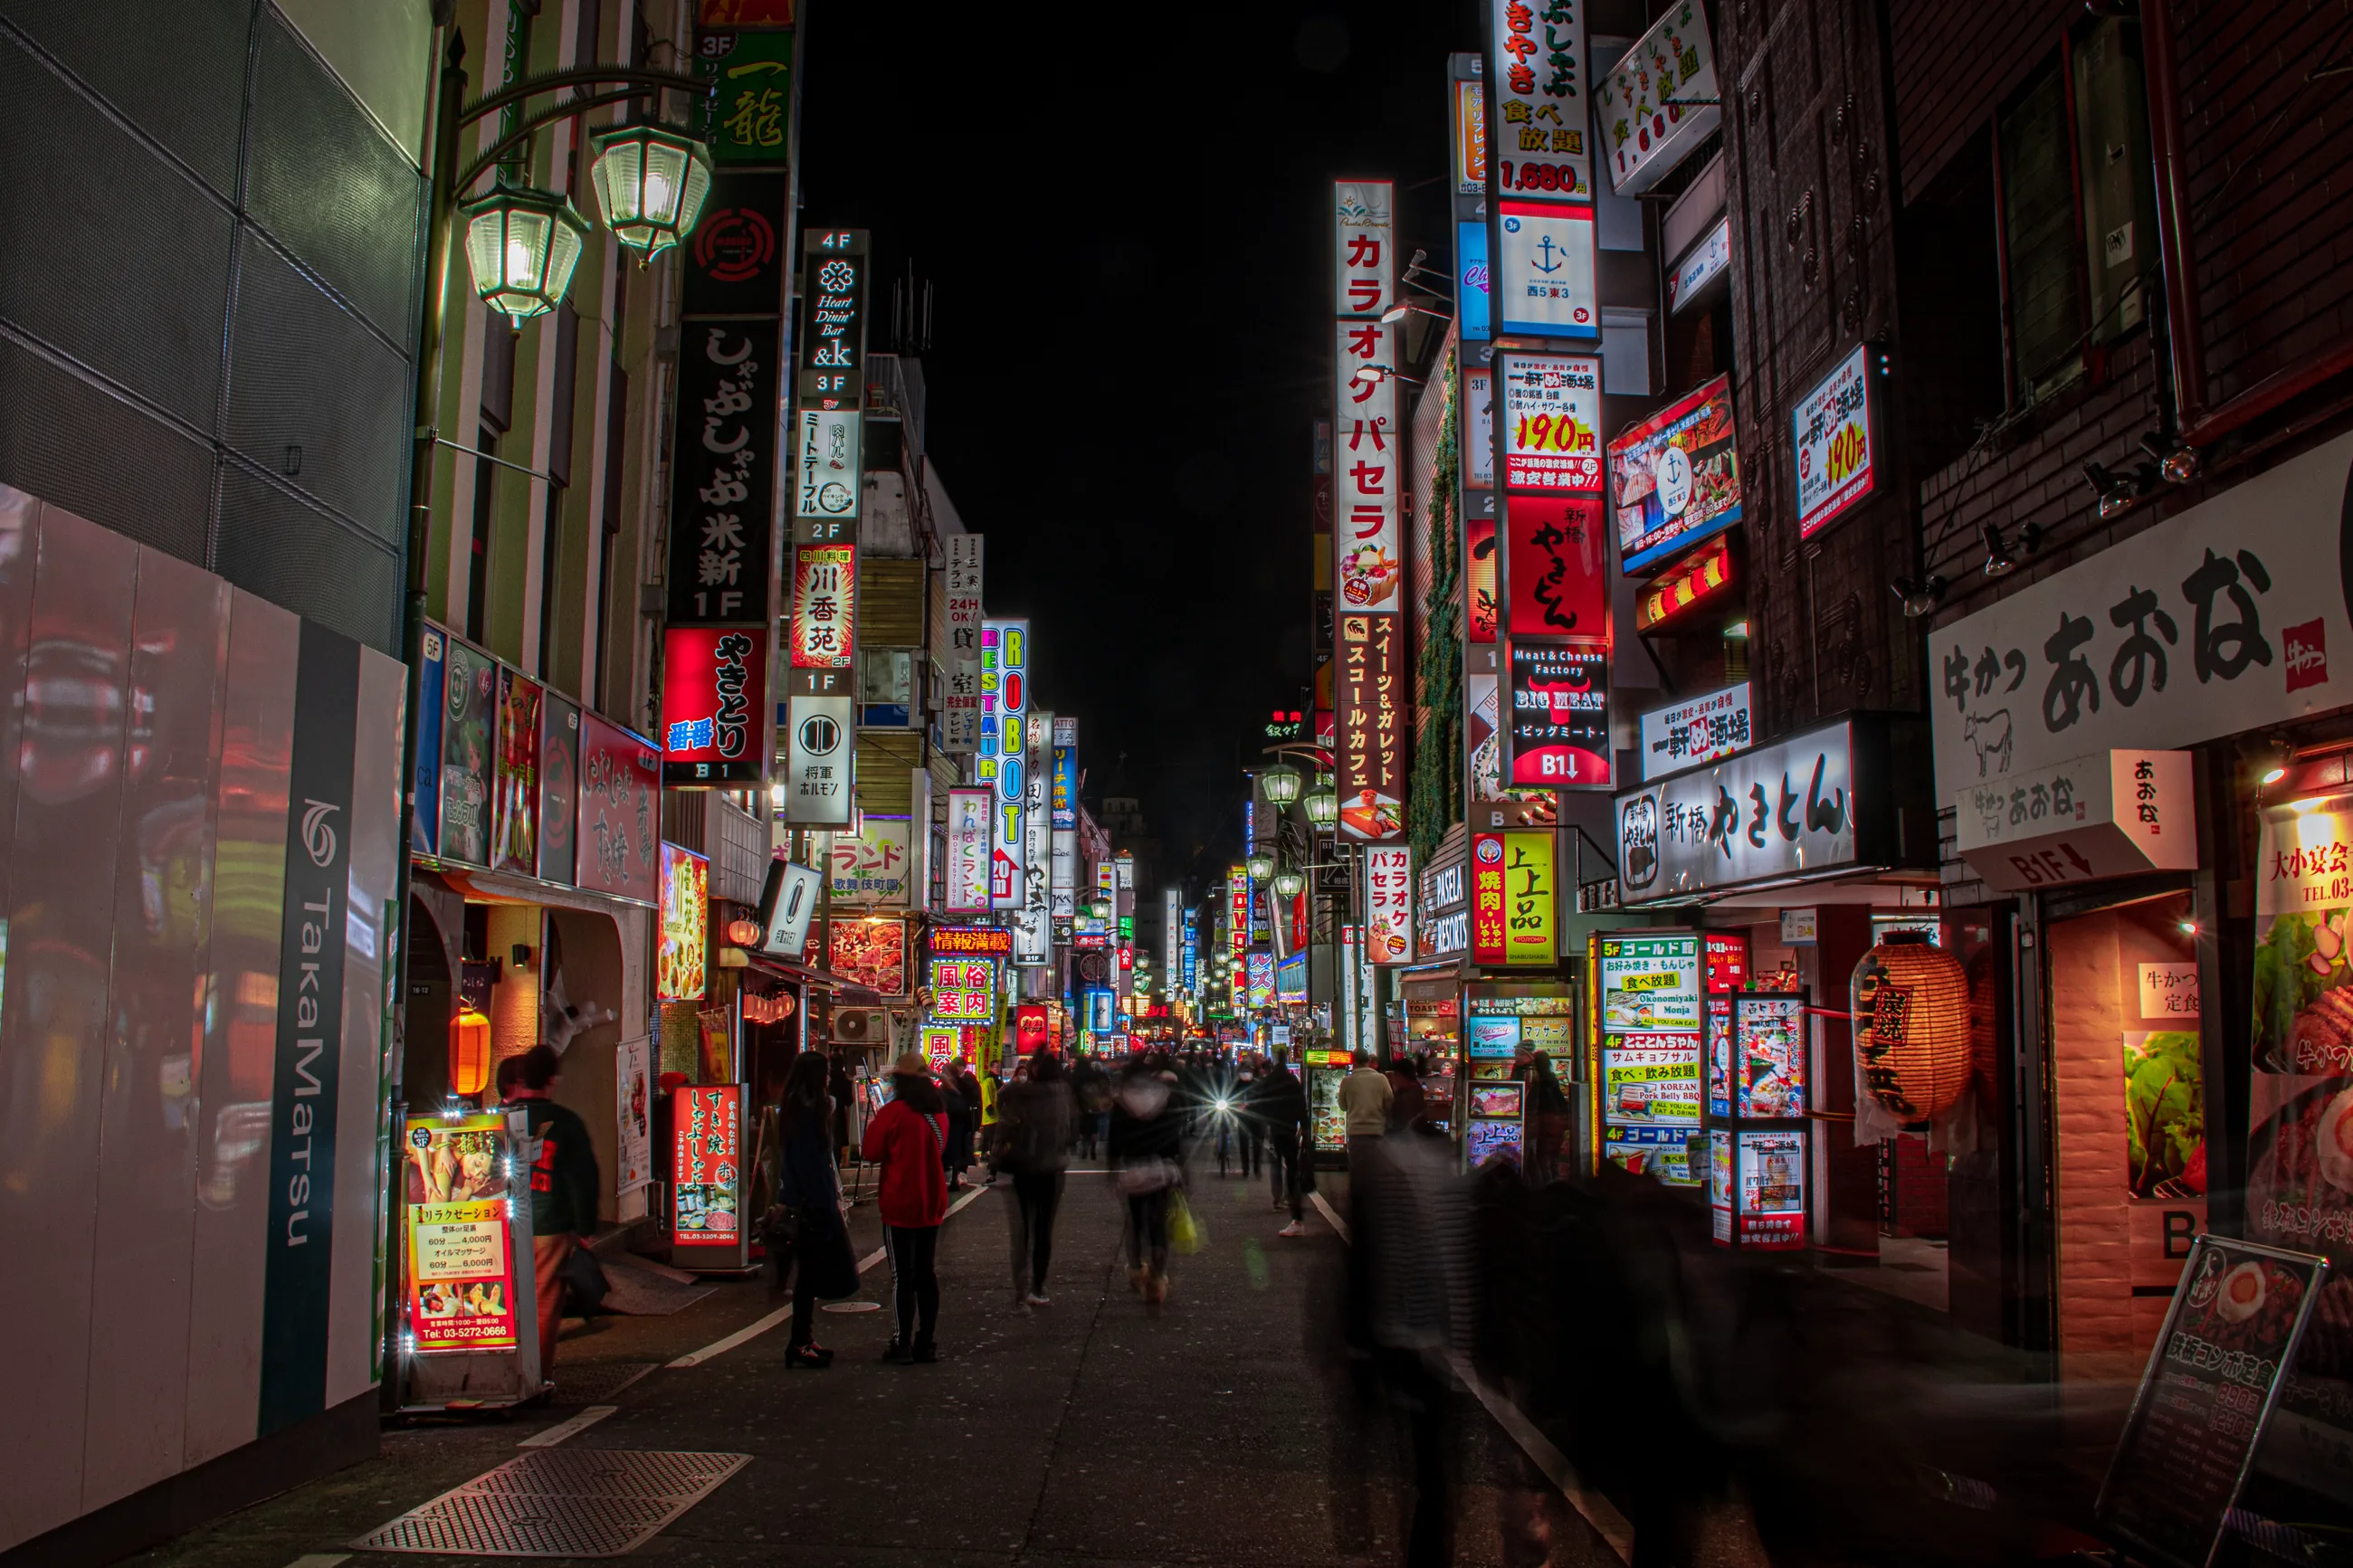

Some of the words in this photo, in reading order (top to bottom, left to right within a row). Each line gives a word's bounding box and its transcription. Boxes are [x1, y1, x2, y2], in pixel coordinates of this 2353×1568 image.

[702, 36, 731, 55] 3F
[724, 62, 788, 147] 一龍
[1506, 220, 1519, 231] 3F
[823, 233, 851, 248] 4F
[817, 296, 853, 308] Heart
[1575, 310, 1588, 320] 3F
[821, 324, 845, 337] Bar
[814, 339, 852, 366] &k
[1513, 362, 1589, 373] 毎日が激安・品質が自慢
[816, 376, 845, 391] 3F
[1472, 379, 1488, 391] 3F
[1508, 371, 1596, 390] 一軒め酒場
[823, 399, 840, 410] 3F
[1798, 375, 1864, 449] 一軒め酒場
[831, 423, 845, 459] 肉バル
[1516, 412, 1596, 452] 190円
[802, 413, 819, 515] ミートテーブル
[1800, 454, 1810, 475] 2F
[1827, 421, 1867, 490] 190円
[1583, 461, 1596, 472] 2F
[1510, 470, 1599, 488] 激安営業中!!
[812, 524, 840, 538] 2F
[1563, 507, 1586, 545] 新橋
[799, 549, 851, 563] 四川料理
[1529, 520, 1578, 630] やきとん
[694, 592, 743, 616] 1F
[807, 565, 839, 653] 川香苑
[949, 598, 979, 611] 24H
[951, 612, 977, 622] OK!
[427, 638, 439, 657] 5F
[1514, 651, 1547, 661] Meat
[1548, 651, 1558, 661] &
[1559, 651, 1604, 662] Cheese
[832, 656, 851, 668] 2F
[1317, 654, 1329, 663] 4F
[1535, 664, 1584, 677] Factory
[481, 675, 491, 689] 4F
[807, 675, 834, 689] 1F
[716, 632, 753, 759] やきとり
[947, 696, 978, 708] 完全個室
[1375, 616, 1396, 787] スイーツ&ガレット
[1514, 690, 1550, 709] BIG
[1553, 690, 1605, 710] MEAT
[1347, 646, 1369, 787] スコールカフェ
[1663, 692, 1733, 726] 毎日が激安・品質が自慢
[569, 713, 577, 728] 2F
[949, 711, 961, 745] テレビ有
[962, 711, 974, 745] シャワー有
[1002, 628, 1025, 843] ROBOT
[1652, 708, 1749, 760] 一軒め酒場
[642, 750, 653, 768] 1F
[1541, 754, 1565, 775] B1
[695, 763, 729, 778] B1
[805, 766, 833, 780] 将軍
[799, 782, 840, 796] ホルモン
[2135, 759, 2160, 824] あおな
[980, 796, 988, 822] 歌舞伎町
[979, 829, 987, 854] 24時間
[1624, 818, 1657, 848] やきとん
[962, 800, 977, 903] わんぱくランド
[2007, 845, 2068, 886] B1F
[2269, 841, 2353, 882] 大小宴会
[834, 878, 899, 891] 歌舞伎町園
[1370, 852, 1388, 908] パセラ
[1391, 851, 1409, 927] カラオケ
[1436, 865, 1463, 908] PASELA
[1506, 846, 1549, 930] 上上品
[834, 926, 862, 934] とくちゃん
[1436, 912, 1468, 954] RESORTS
[834, 936, 875, 955] ホルモン
[934, 932, 1008, 950] 情報満載
[1604, 943, 1620, 956] 5F
[1605, 960, 1695, 972] お好み焼き・もんじゃ
[936, 964, 988, 990] 風俗
[1626, 974, 1676, 990] 食べ放題
[2145, 970, 2197, 990] 牛かつ
[938, 991, 987, 1016] 案内
[1639, 994, 1699, 1003] Okonomiyaki
[2164, 993, 2199, 1013] 定食
[1663, 1005, 1691, 1015] Monja
[1524, 1024, 1568, 1038] マッサージ
[1605, 1034, 1623, 1048] 4F
[1624, 1035, 1699, 1050] とことんちゃん
[1612, 1051, 1694, 1062] サムギョプサル
[1611, 1065, 1696, 1082] 食べ・飲み放題
[1660, 1083, 1697, 1091] KOREAN
[1639, 1092, 1659, 1100] Pork
[1661, 1092, 1681, 1101] Belly
[1682, 1093, 1700, 1101] BBQ
[706, 1088, 726, 1155] すき焼
[728, 1100, 737, 1156] 家庭的なお店
[686, 1088, 706, 1191] しゃぶしゃぶ
[1477, 1124, 1519, 1145] 上上品
[1607, 1126, 1624, 1140] 4F
[415, 1137, 428, 1148] 3F
[435, 1133, 478, 1155] 一龍
[424, 1207, 500, 1222] リラクゼーション
[442, 1224, 477, 1234] 整体or足裏
[428, 1237, 446, 1246] 60分
[462, 1234, 492, 1245] 4,000円
[434, 1247, 487, 1257] オイルマッサージ
[429, 1260, 447, 1269] 60分
[462, 1258, 493, 1268] 6,000円
[423, 1329, 442, 1339] Tel:
[443, 1326, 507, 1339] 03-5272-0666
